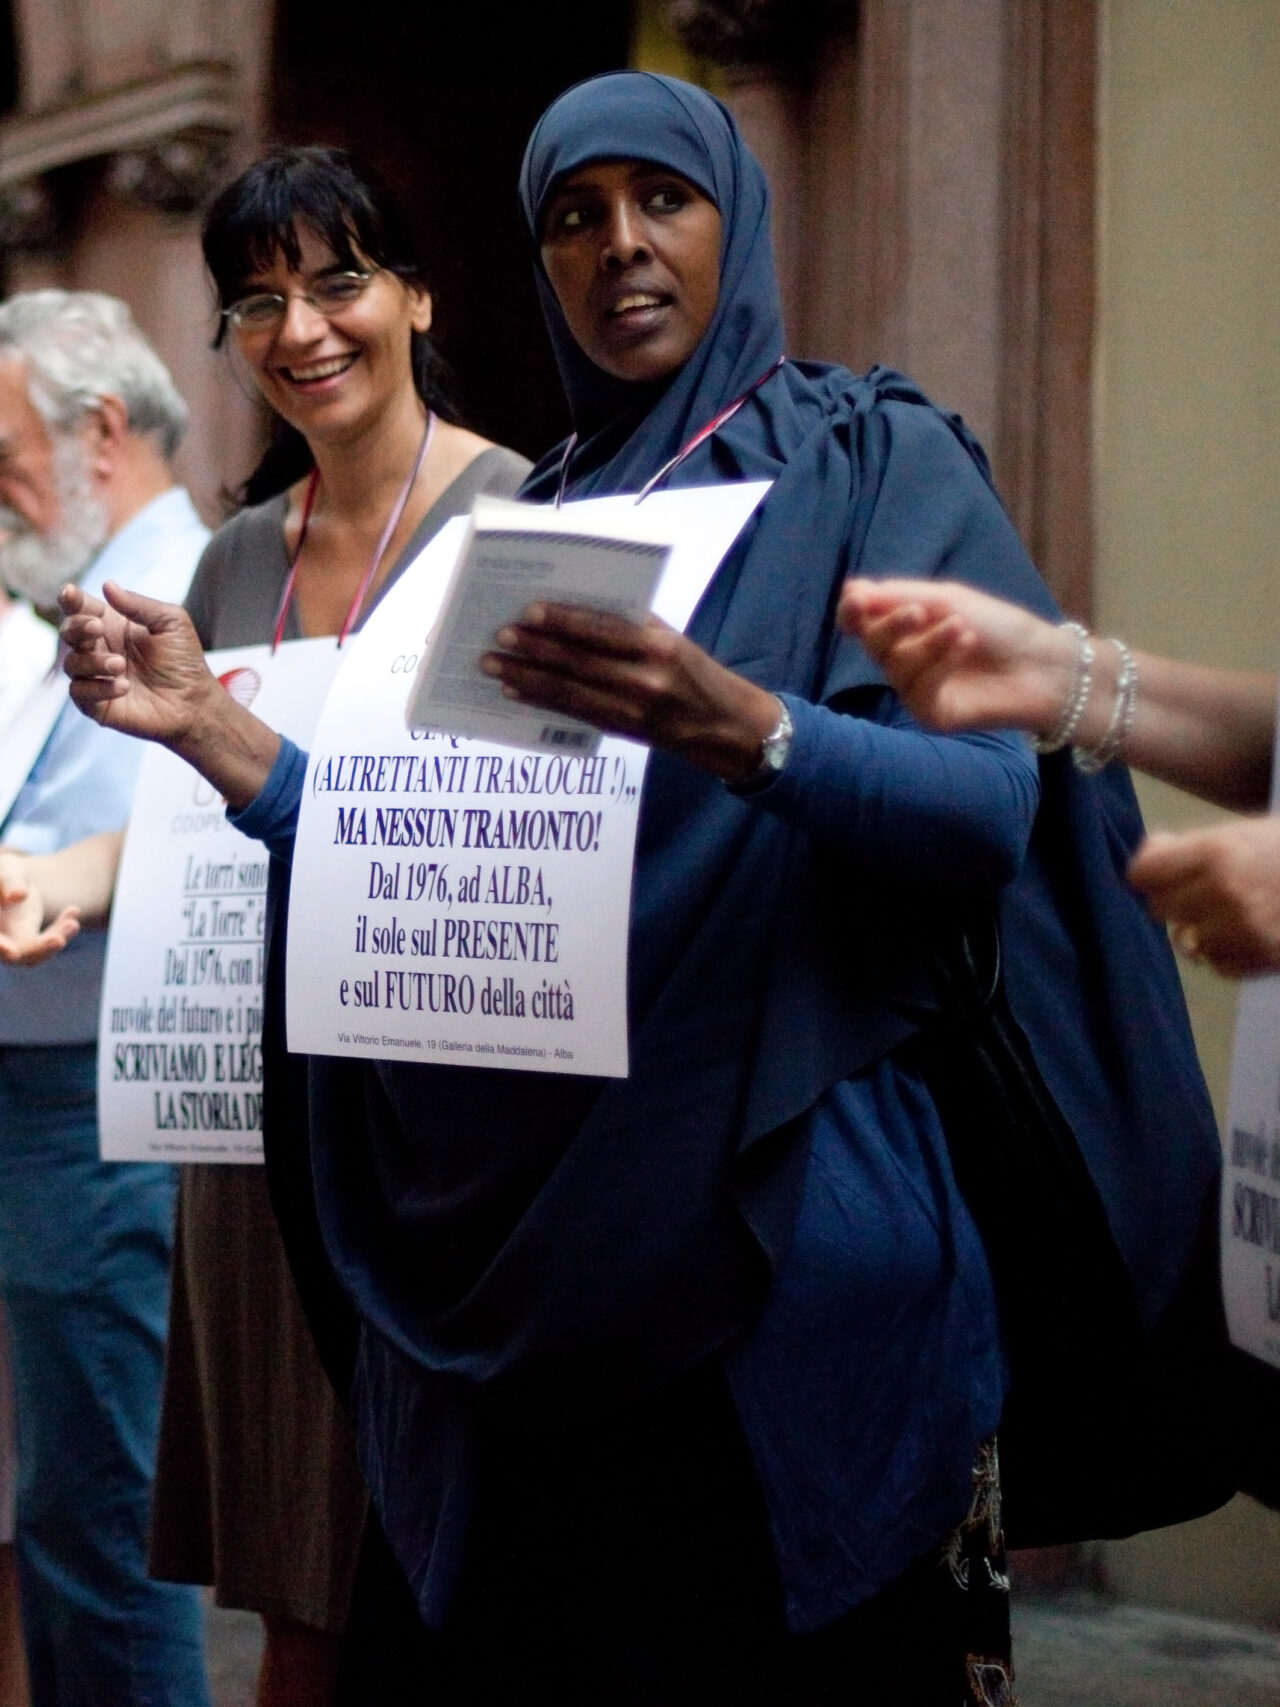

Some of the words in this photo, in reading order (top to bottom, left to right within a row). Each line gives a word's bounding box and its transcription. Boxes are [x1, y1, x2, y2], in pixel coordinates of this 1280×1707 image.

[312, 755, 471, 799] (ALTRETTANTI
[473, 755, 609, 796] TRASLOCHI
[333, 806, 368, 846] MA
[370, 807, 460, 849] NESSUN
[461, 808, 603, 852] TRAMONTO!
[367, 861, 401, 900] Dal
[404, 862, 454, 911] 1976,
[457, 864, 482, 904] ad
[484, 865, 553, 916] ALBA,
[355, 914, 368, 953] il
[371, 916, 407, 956] sole
[410, 918, 438, 957] sul
[441, 919, 560, 963] PRESENTE
[164, 947, 189, 986] Dal
[157, 996, 177, 1034] del
[180, 996, 223, 1034] futuro
[225, 1007, 234, 1034] e
[339, 979, 349, 1007] e
[353, 969, 380, 1008] sul
[384, 970, 475, 1015] FUTURO
[480, 976, 526, 1018] della
[531, 978, 575, 1022] città
[113, 1042, 208, 1083] SCRIVIAMO
[214, 1043, 227, 1082] E
[337, 1032, 351, 1044] Via
[352, 1033, 380, 1046] Vittorio
[426, 1039, 437, 1050] 19
[474, 1044, 496, 1055] della
[496, 1043, 547, 1059] Maddalena)
[554, 1048, 574, 1060] Alba
[155, 1091, 178, 1131] LA
[180, 1092, 242, 1131] STORIA
